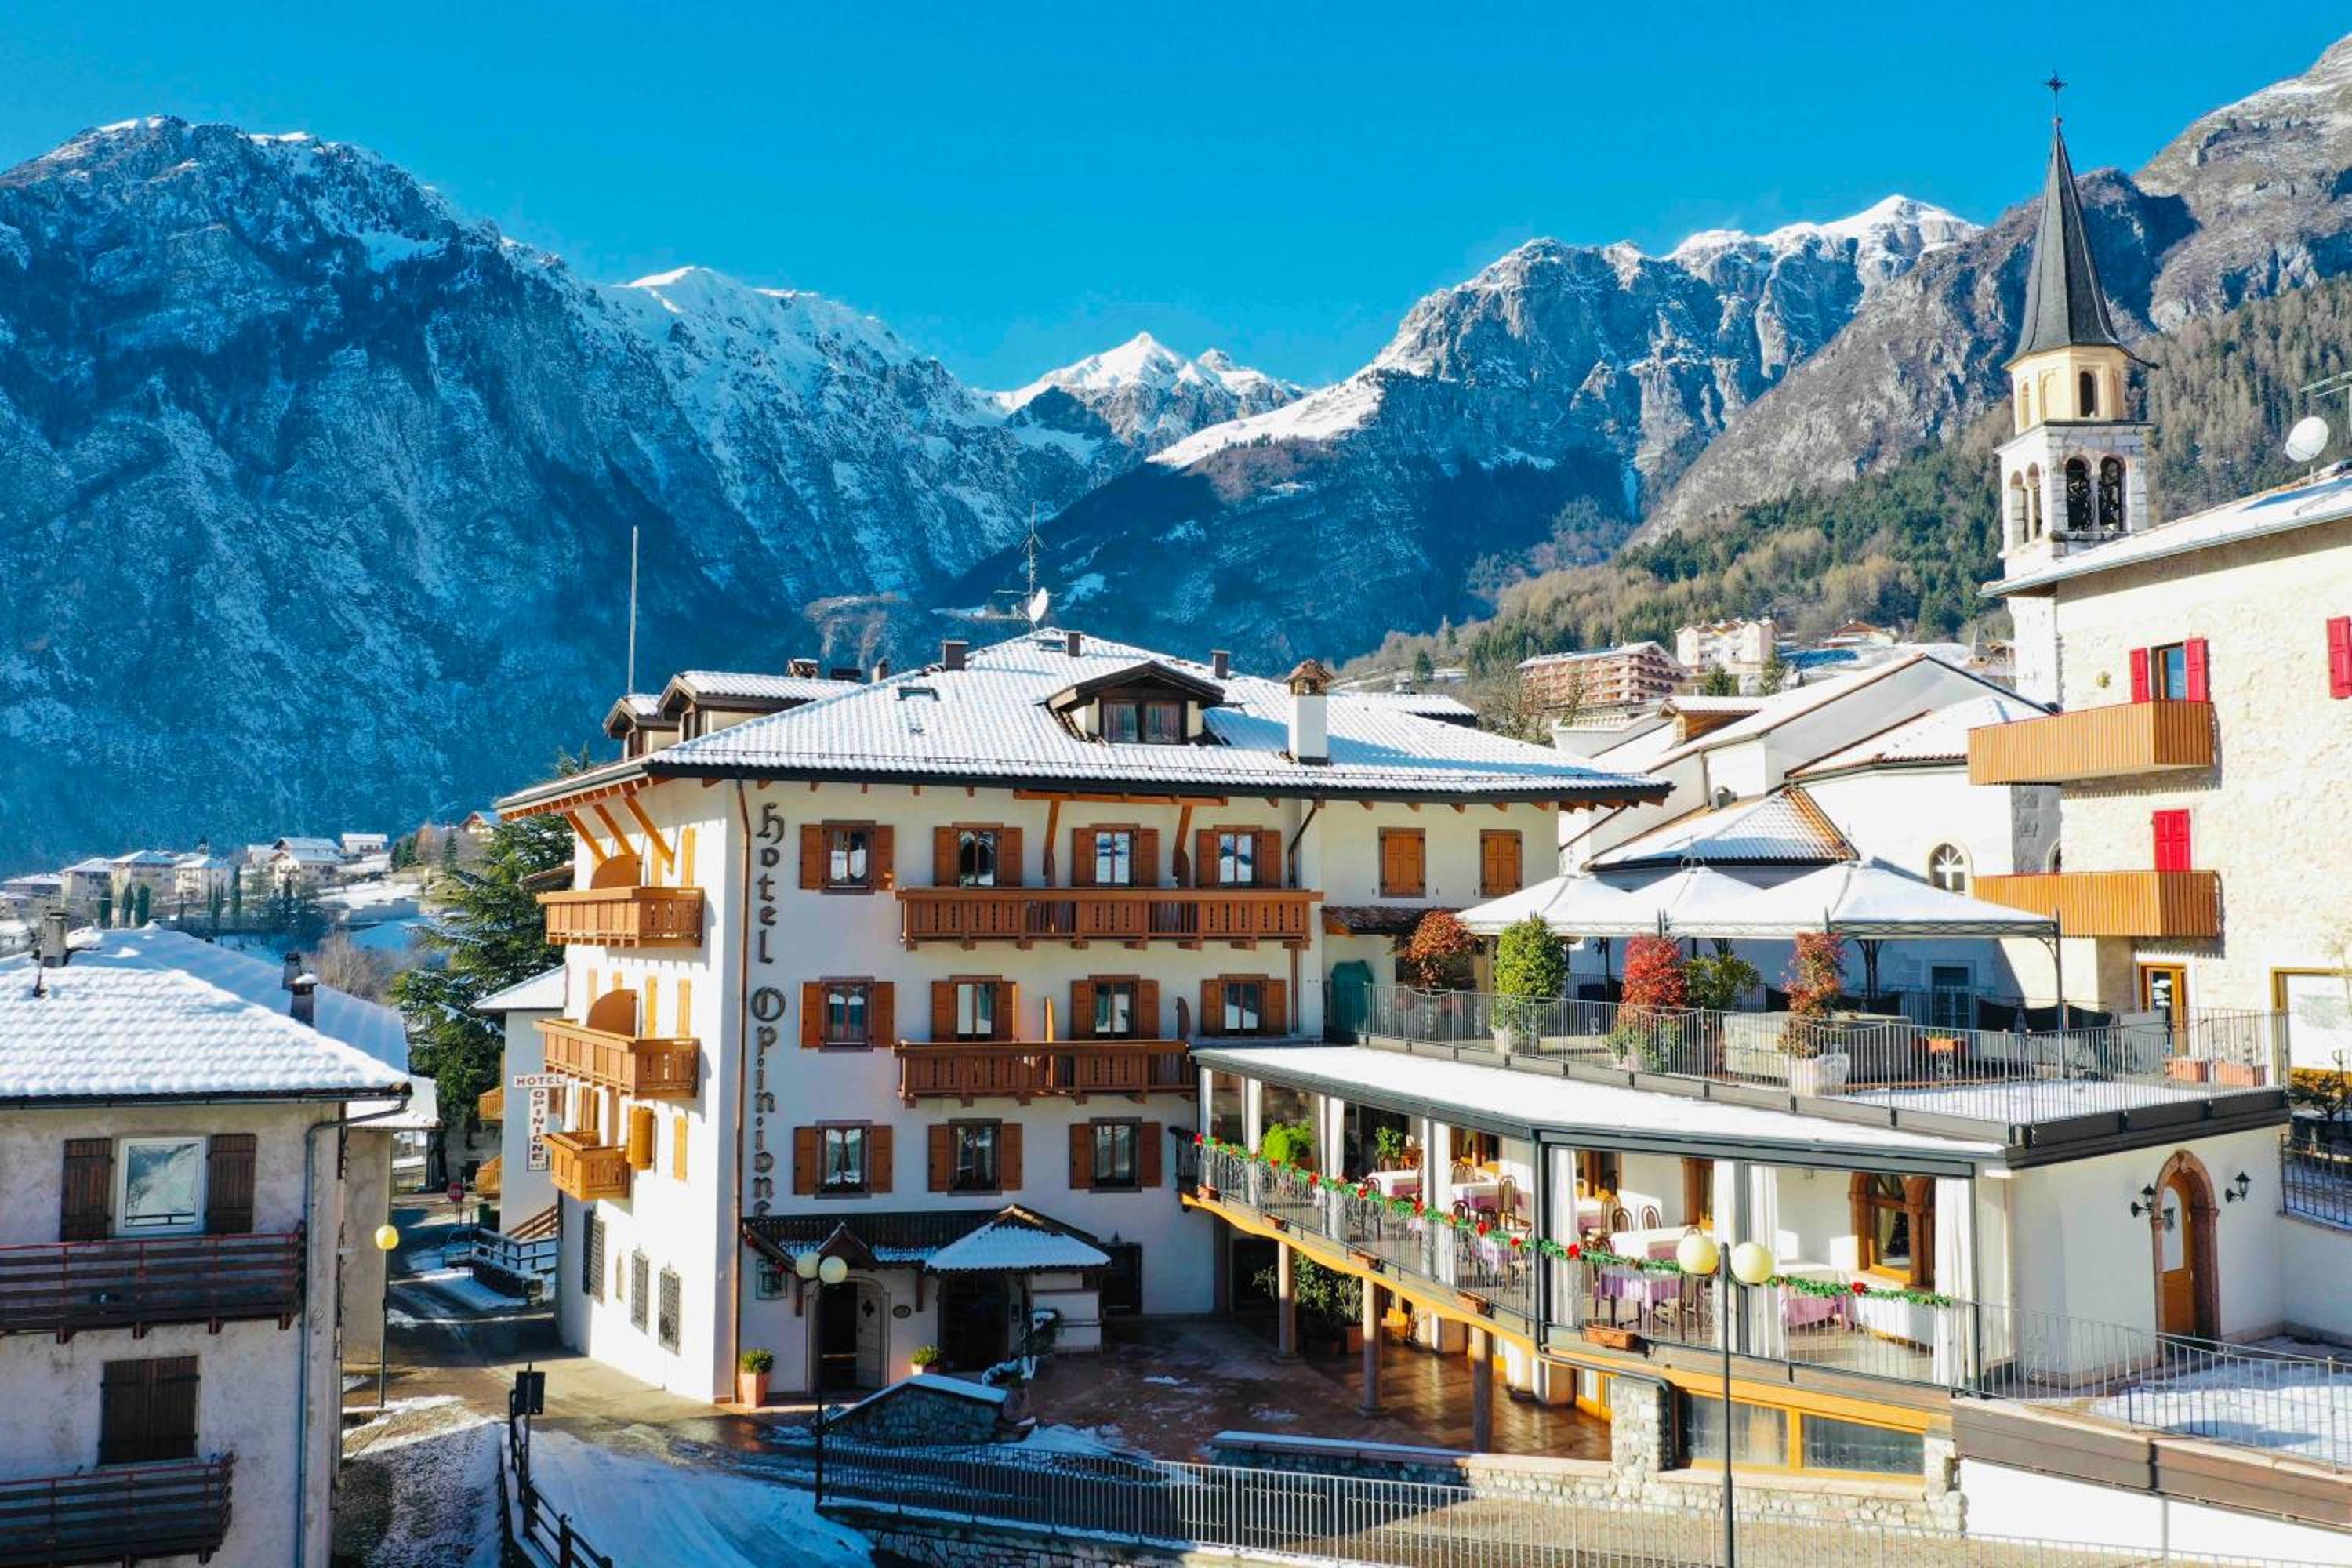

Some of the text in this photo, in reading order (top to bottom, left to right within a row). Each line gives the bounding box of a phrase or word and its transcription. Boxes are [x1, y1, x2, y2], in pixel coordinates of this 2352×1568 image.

[516, 1076, 563, 1086] HOTEL
[751, 987, 786, 1218] Opinione
[532, 1091, 545, 1160] OPINIONE
